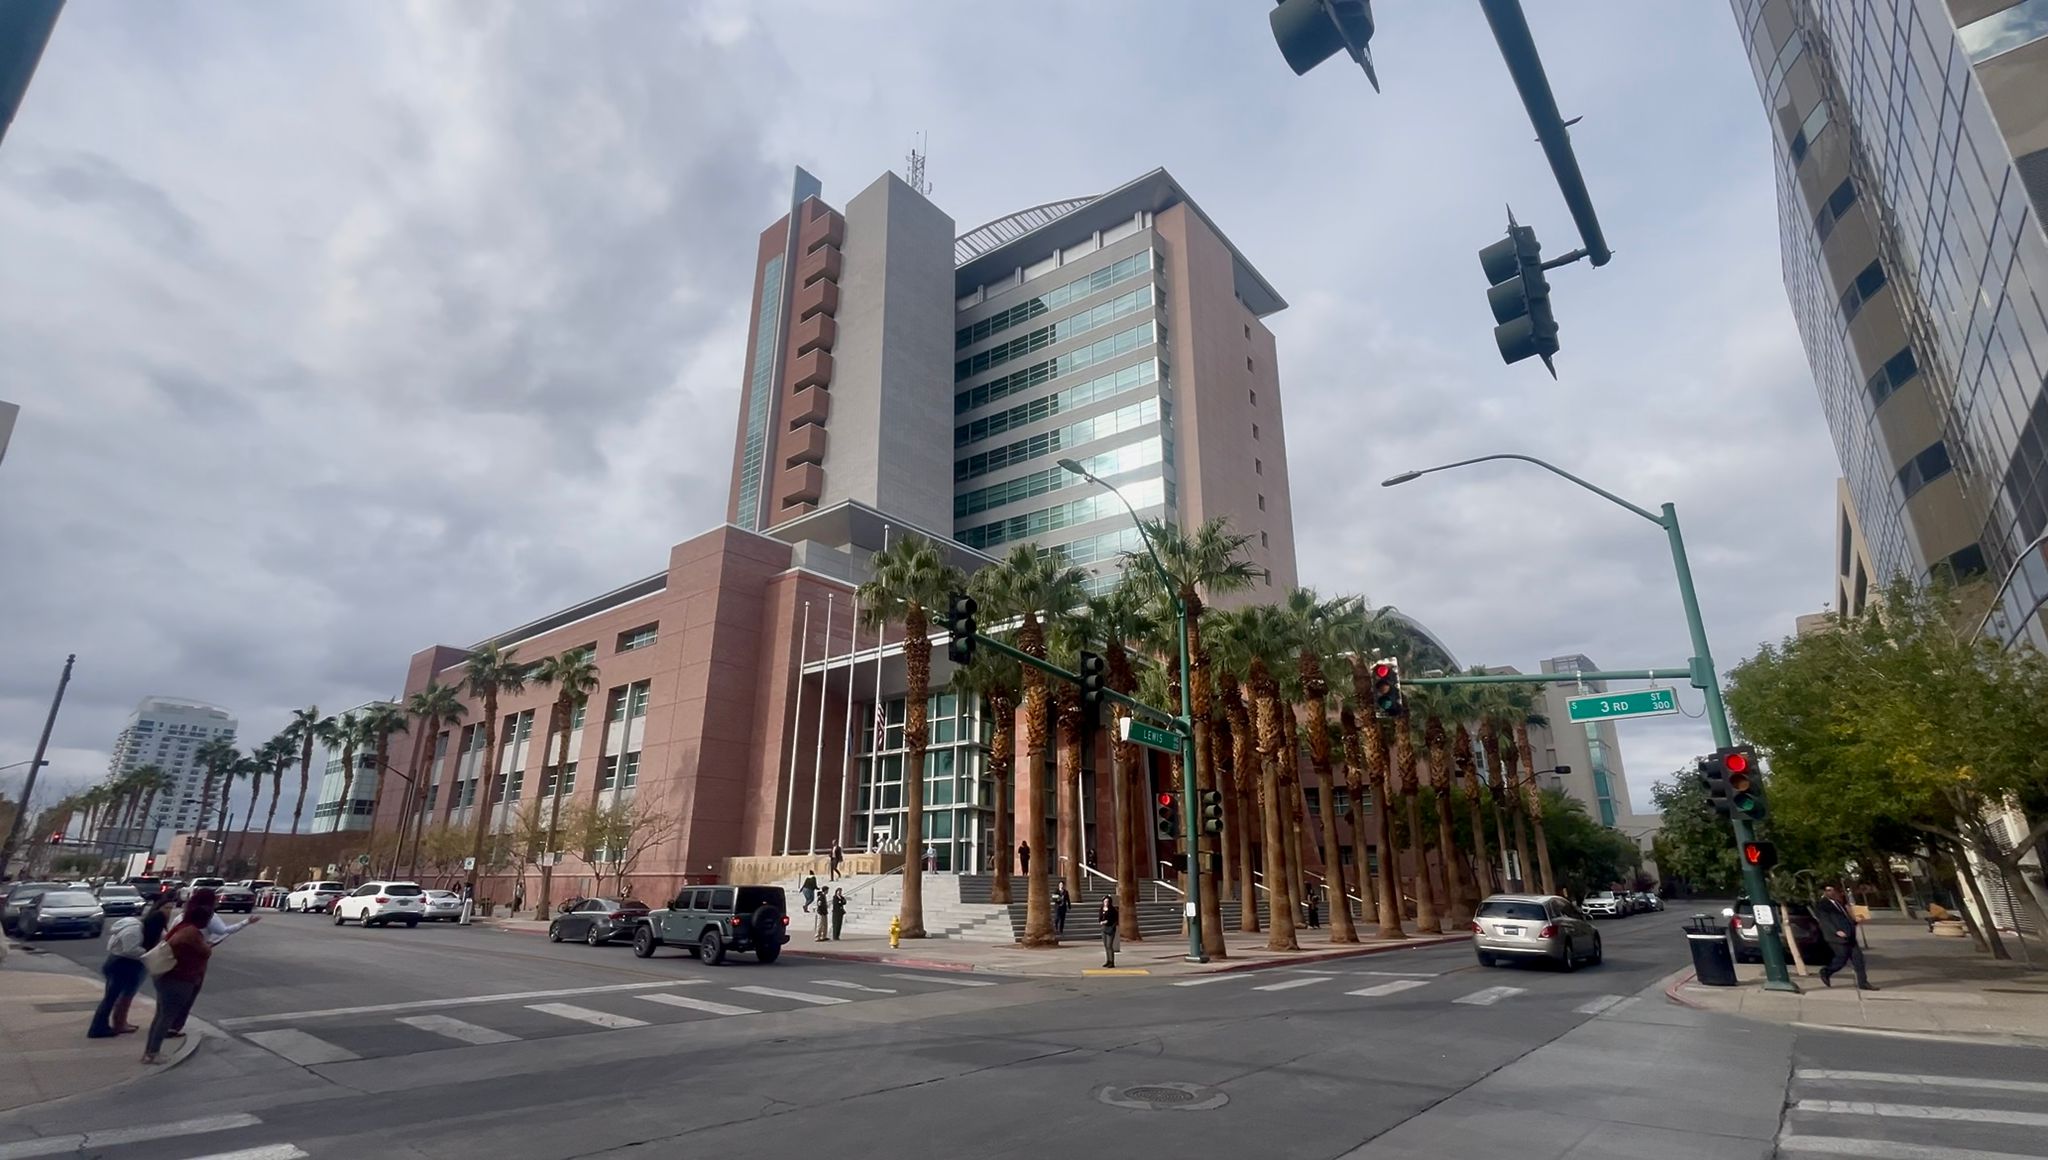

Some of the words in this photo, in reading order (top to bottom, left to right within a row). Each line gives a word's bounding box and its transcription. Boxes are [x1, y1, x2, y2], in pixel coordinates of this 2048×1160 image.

[1651, 693, 1661, 701] ST
[1572, 702, 1578, 710] S
[1600, 701, 1610, 713] 3
[1613, 701, 1629, 712] RD
[1653, 701, 1670, 710] 300
[1144, 730, 1163, 744] LEWIS
